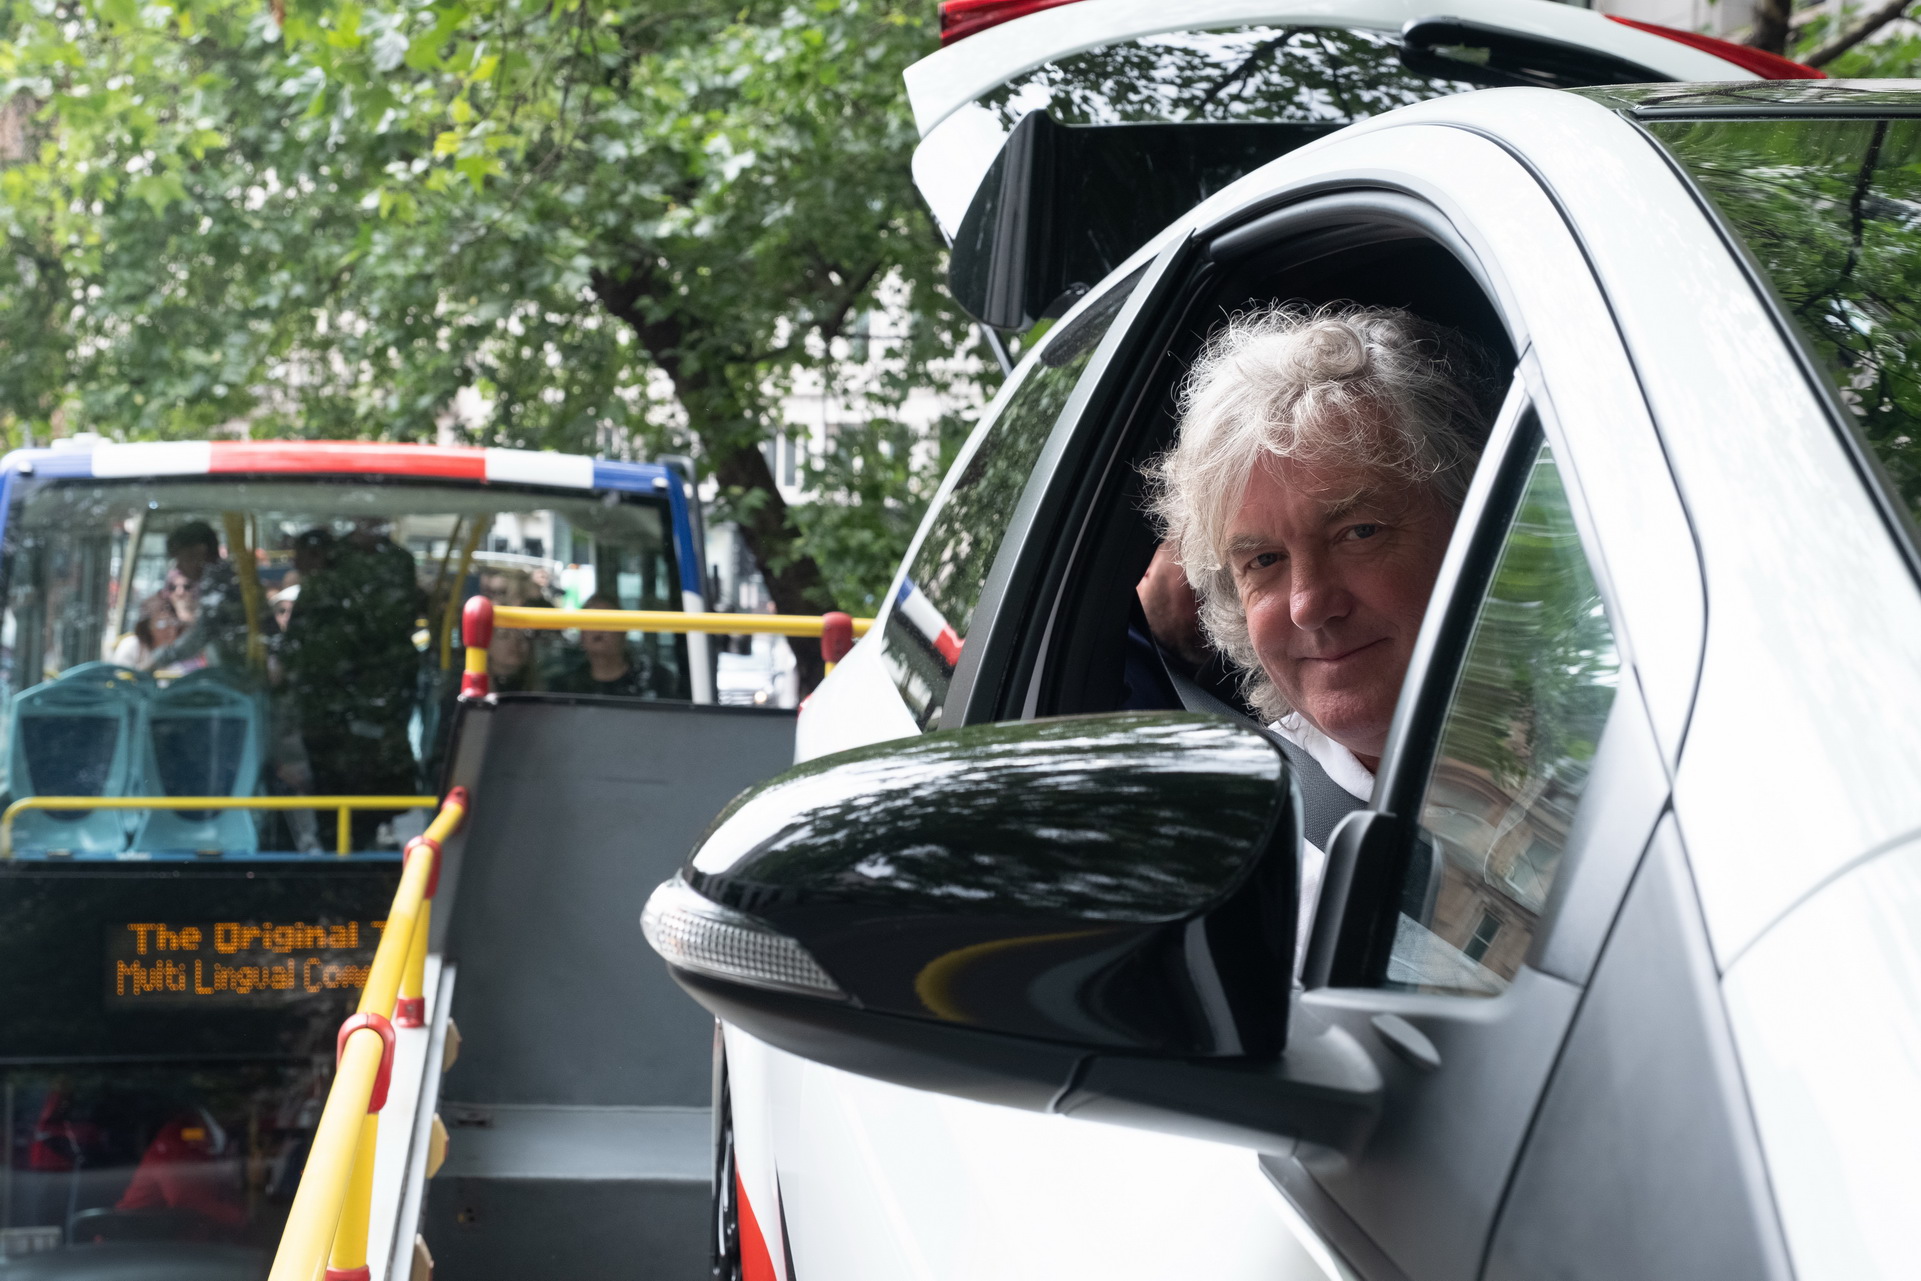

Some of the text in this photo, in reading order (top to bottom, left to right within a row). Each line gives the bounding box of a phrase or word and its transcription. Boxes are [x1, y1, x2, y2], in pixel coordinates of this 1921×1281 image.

[128, 922, 202, 955] The
[214, 921, 359, 953] Original
[116, 959, 187, 996] Multi
[194, 957, 295, 995] Lingual
